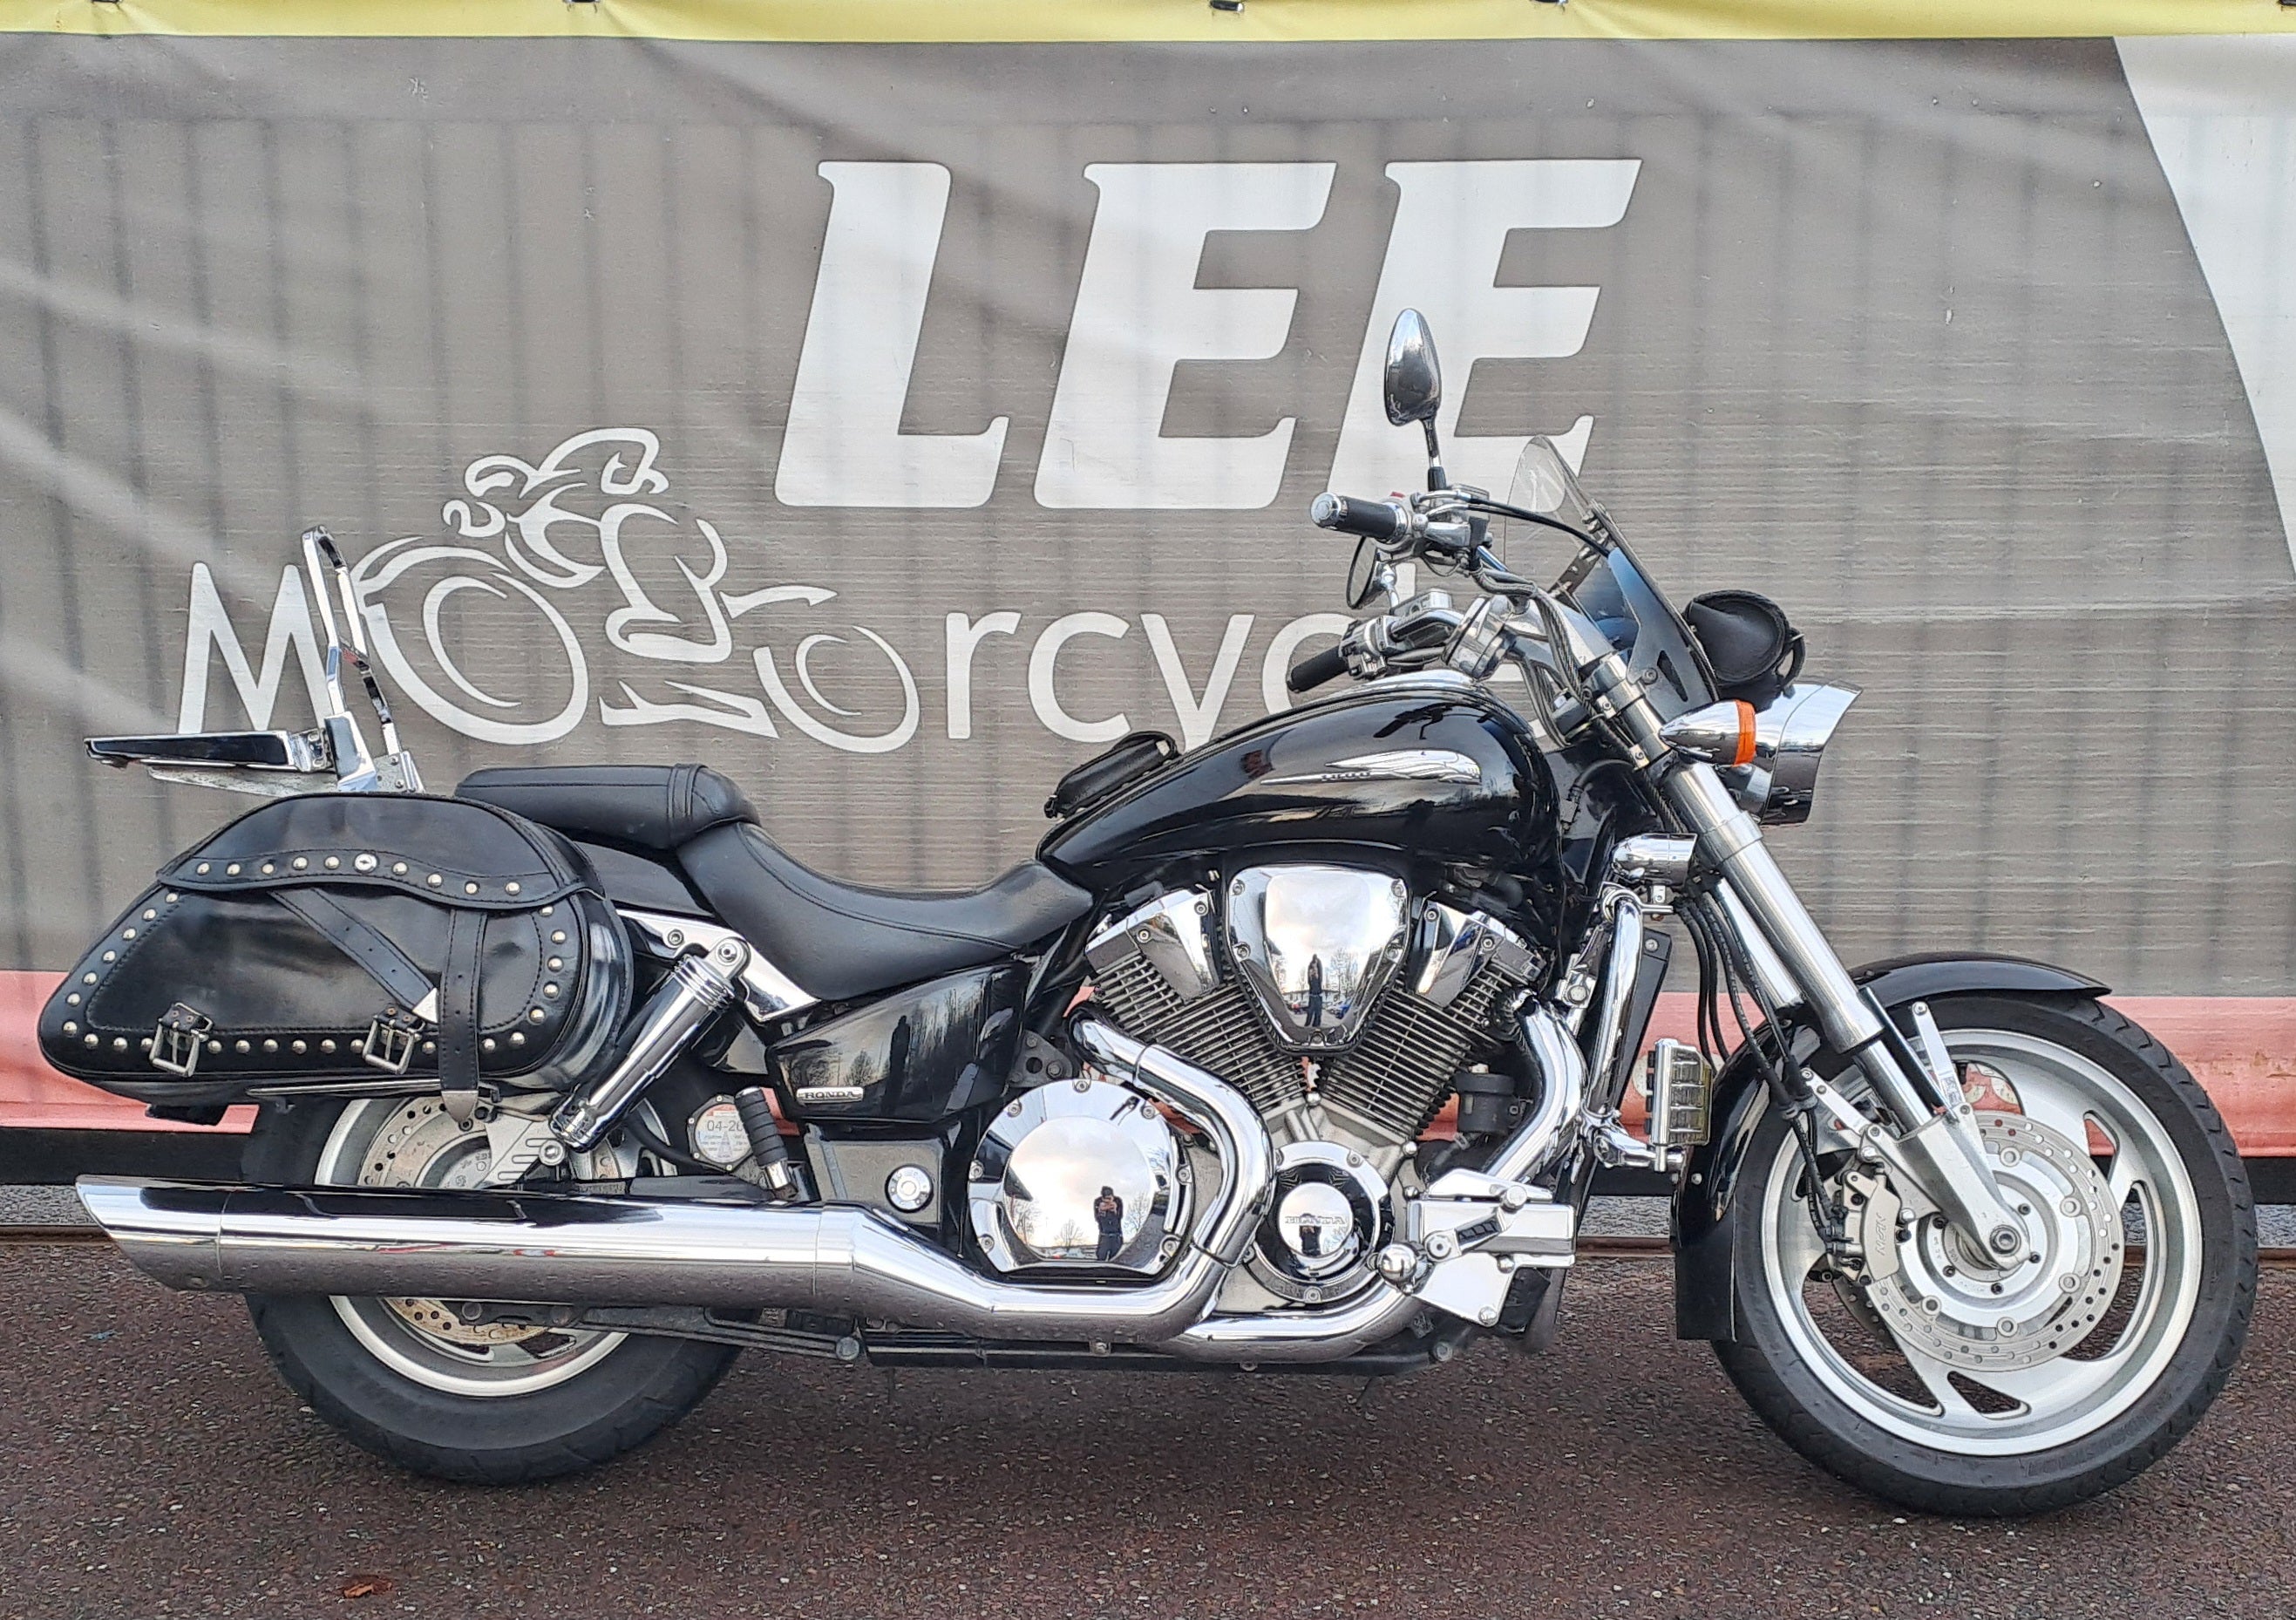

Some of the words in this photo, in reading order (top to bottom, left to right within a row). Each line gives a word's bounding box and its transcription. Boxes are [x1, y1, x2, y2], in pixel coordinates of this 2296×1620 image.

[774, 159, 1641, 510] LEE
[805, 1090, 855, 1099] HONDA
[707, 1120, 744, 1132] 04-20
